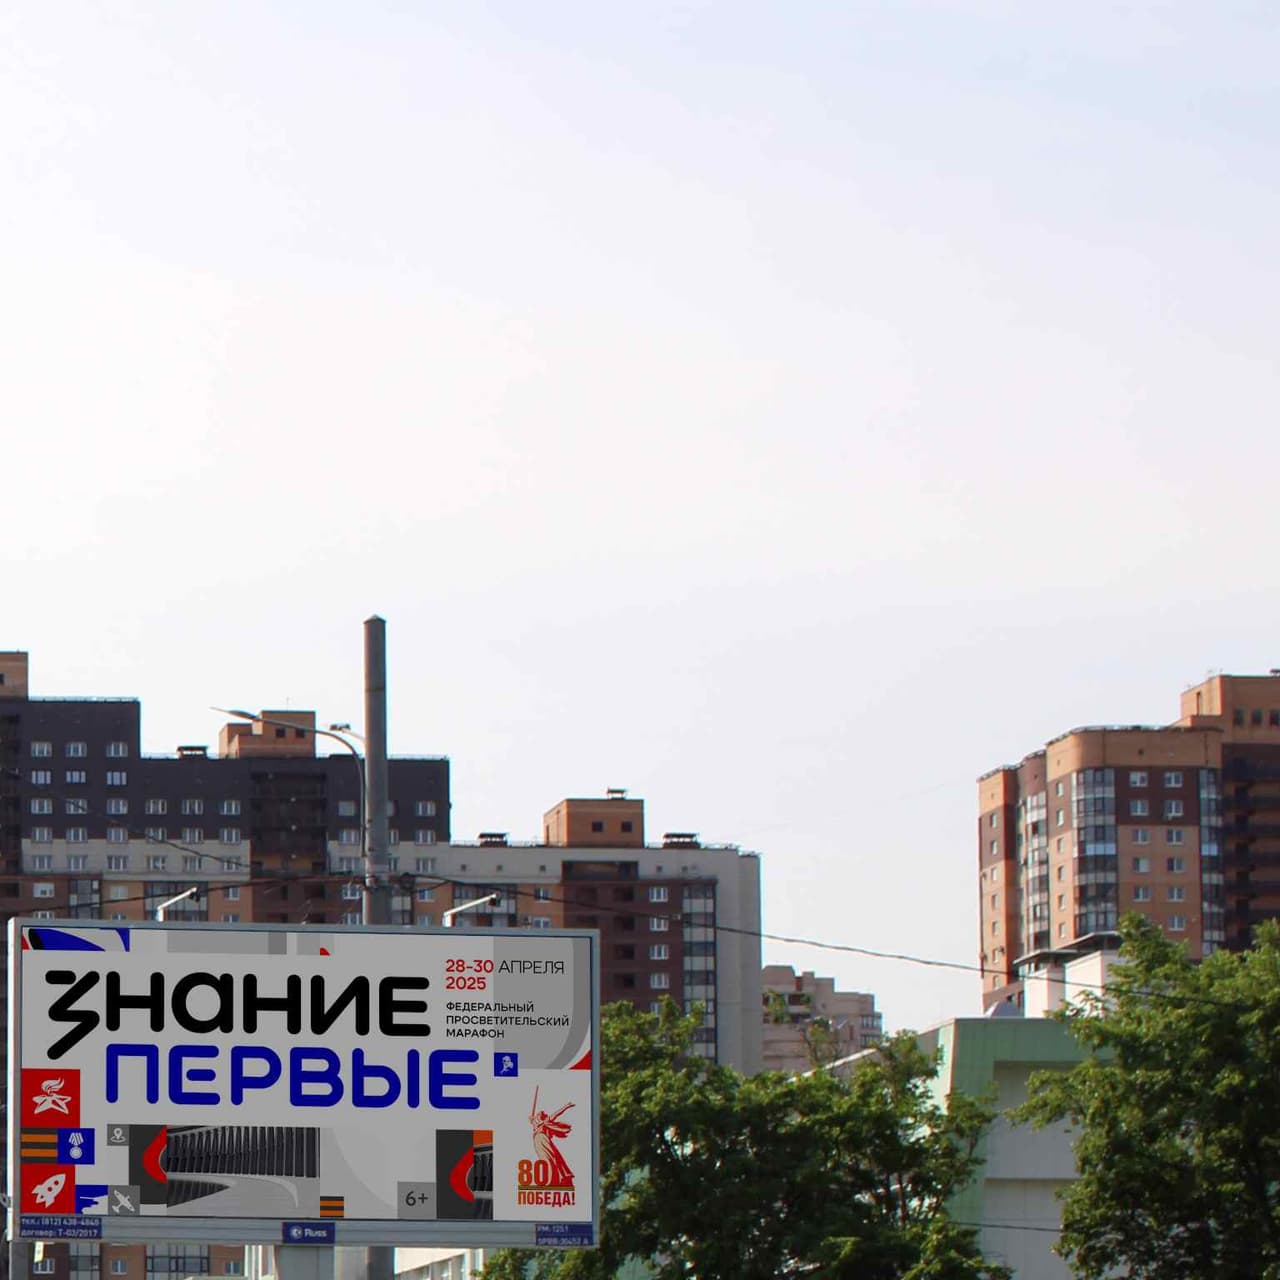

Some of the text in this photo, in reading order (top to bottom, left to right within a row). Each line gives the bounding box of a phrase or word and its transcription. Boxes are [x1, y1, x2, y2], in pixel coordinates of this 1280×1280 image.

[445, 959, 565, 974] 28-30 АПРЕЛЯ
[445, 976, 487, 990] 2025
[446, 1001, 534, 1013] ФЕДЕРАЛЬНЫЙ
[446, 1014, 569, 1026] ПРОСВЕТИТЕЛЬСКИЙ
[446, 1028, 505, 1038] МАРАФОН
[105, 1043, 481, 1110] ПЕРВЫЕ
[517, 1159, 550, 1186] 80
[405, 1191, 428, 1206] 6+
[517, 1191, 576, 1207] ПОБЕДА!
[304, 1228, 328, 1237] Russ
